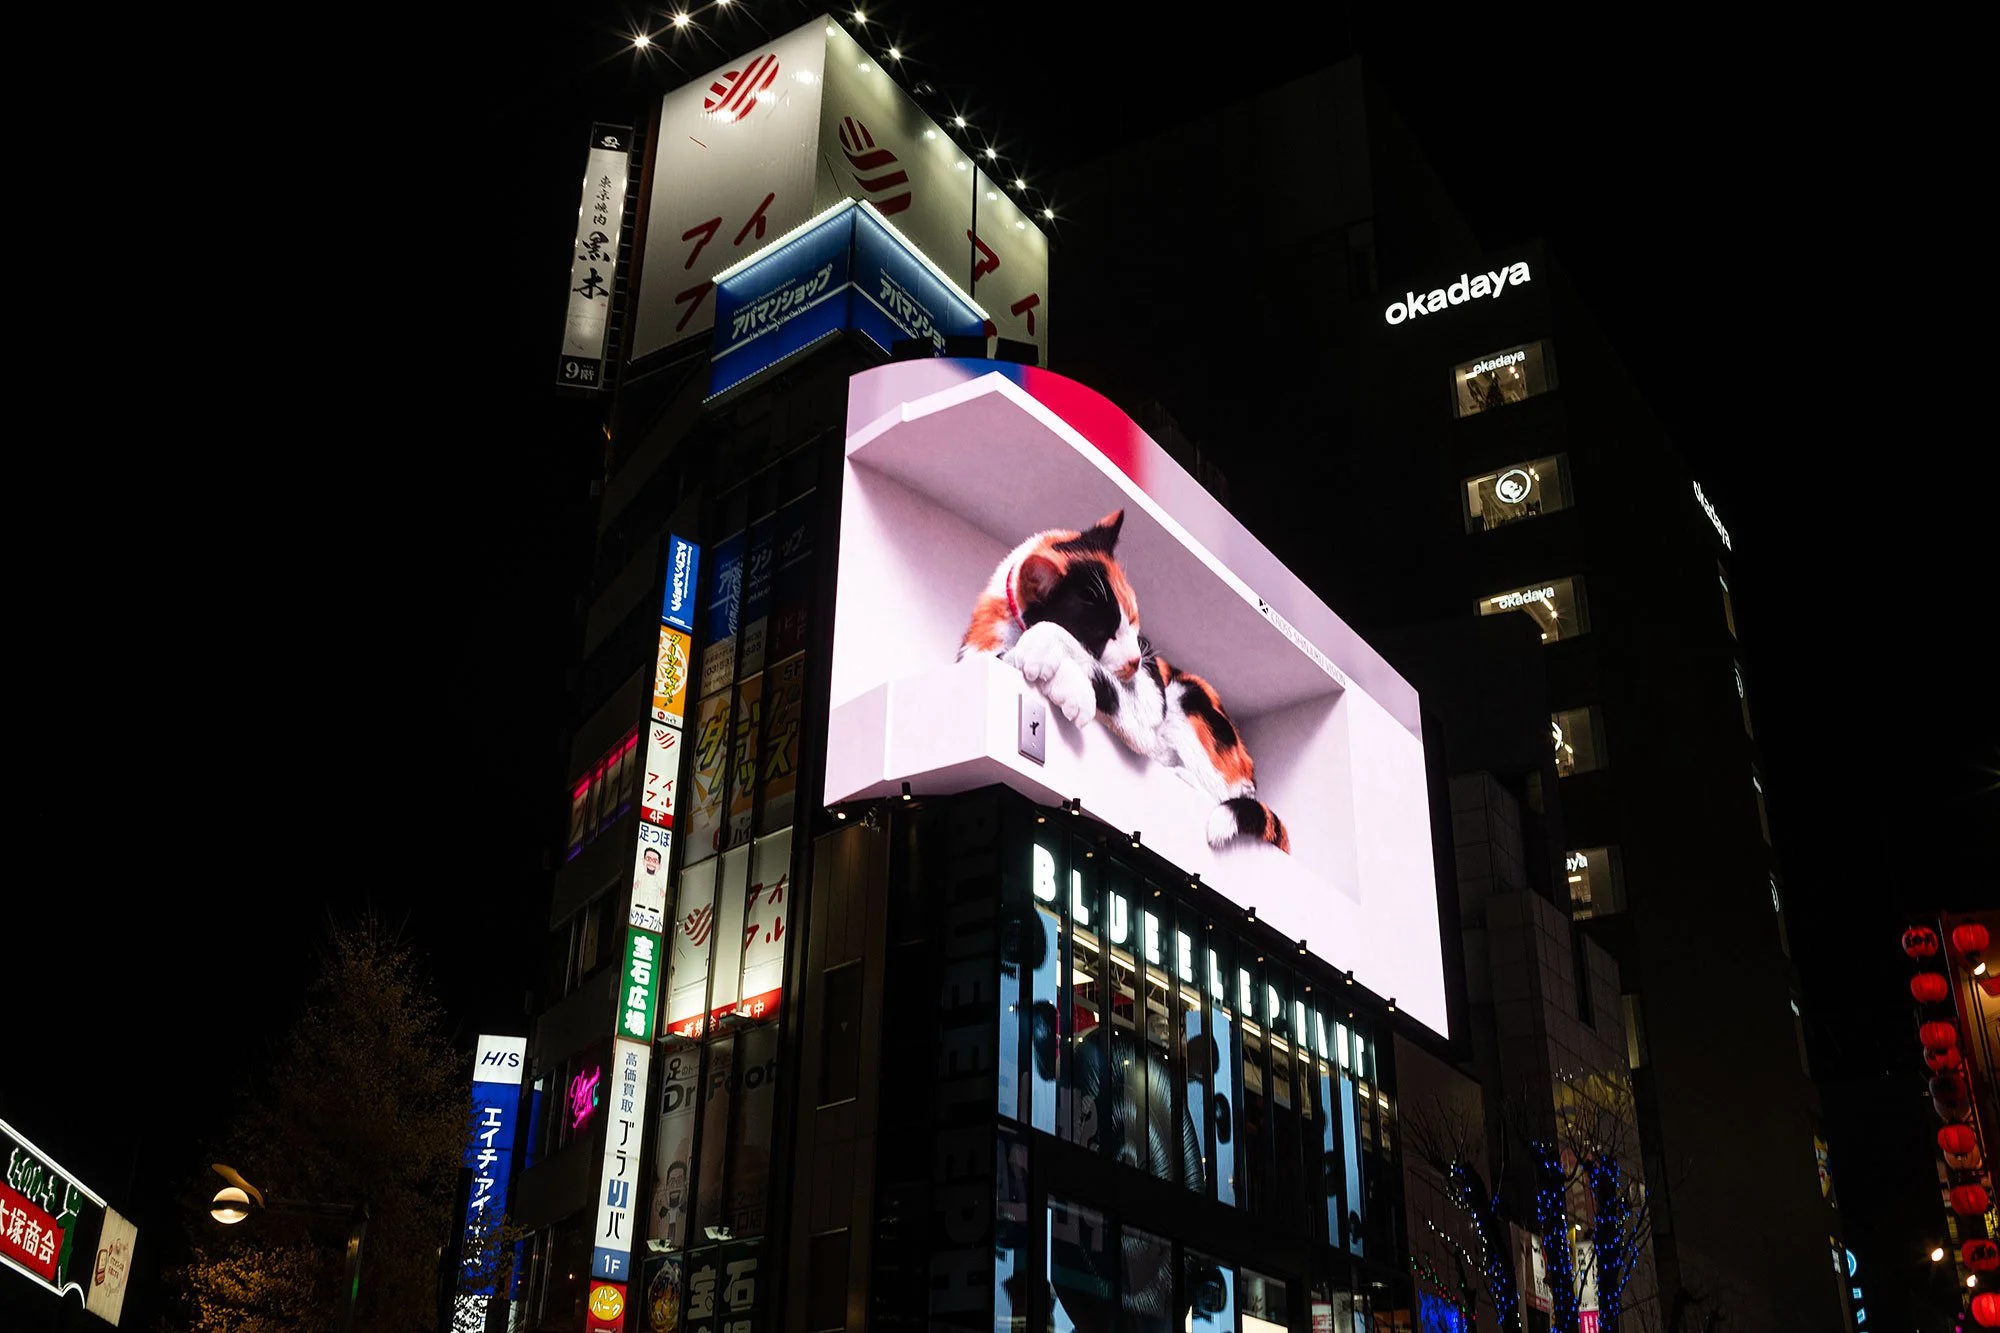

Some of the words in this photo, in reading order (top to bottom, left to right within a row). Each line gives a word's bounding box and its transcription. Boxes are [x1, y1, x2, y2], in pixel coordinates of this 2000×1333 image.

[682, 192, 776, 270] アイ
[732, 262, 834, 340] アパマンショップ
[1384, 260, 1532, 327] okadaya
[1473, 350, 1526, 376] okadaya
[1499, 586, 1556, 611] okadaya
[645, 790, 673, 809] フル
[647, 772, 675, 793] アイ
[648, 810, 665, 824] 4F
[623, 933, 655, 1037] 宝石広場
[619, 1052, 638, 1115] 高価買取
[606, 1119, 635, 1240] ブラリバ
[603, 1253, 621, 1275] 1F
